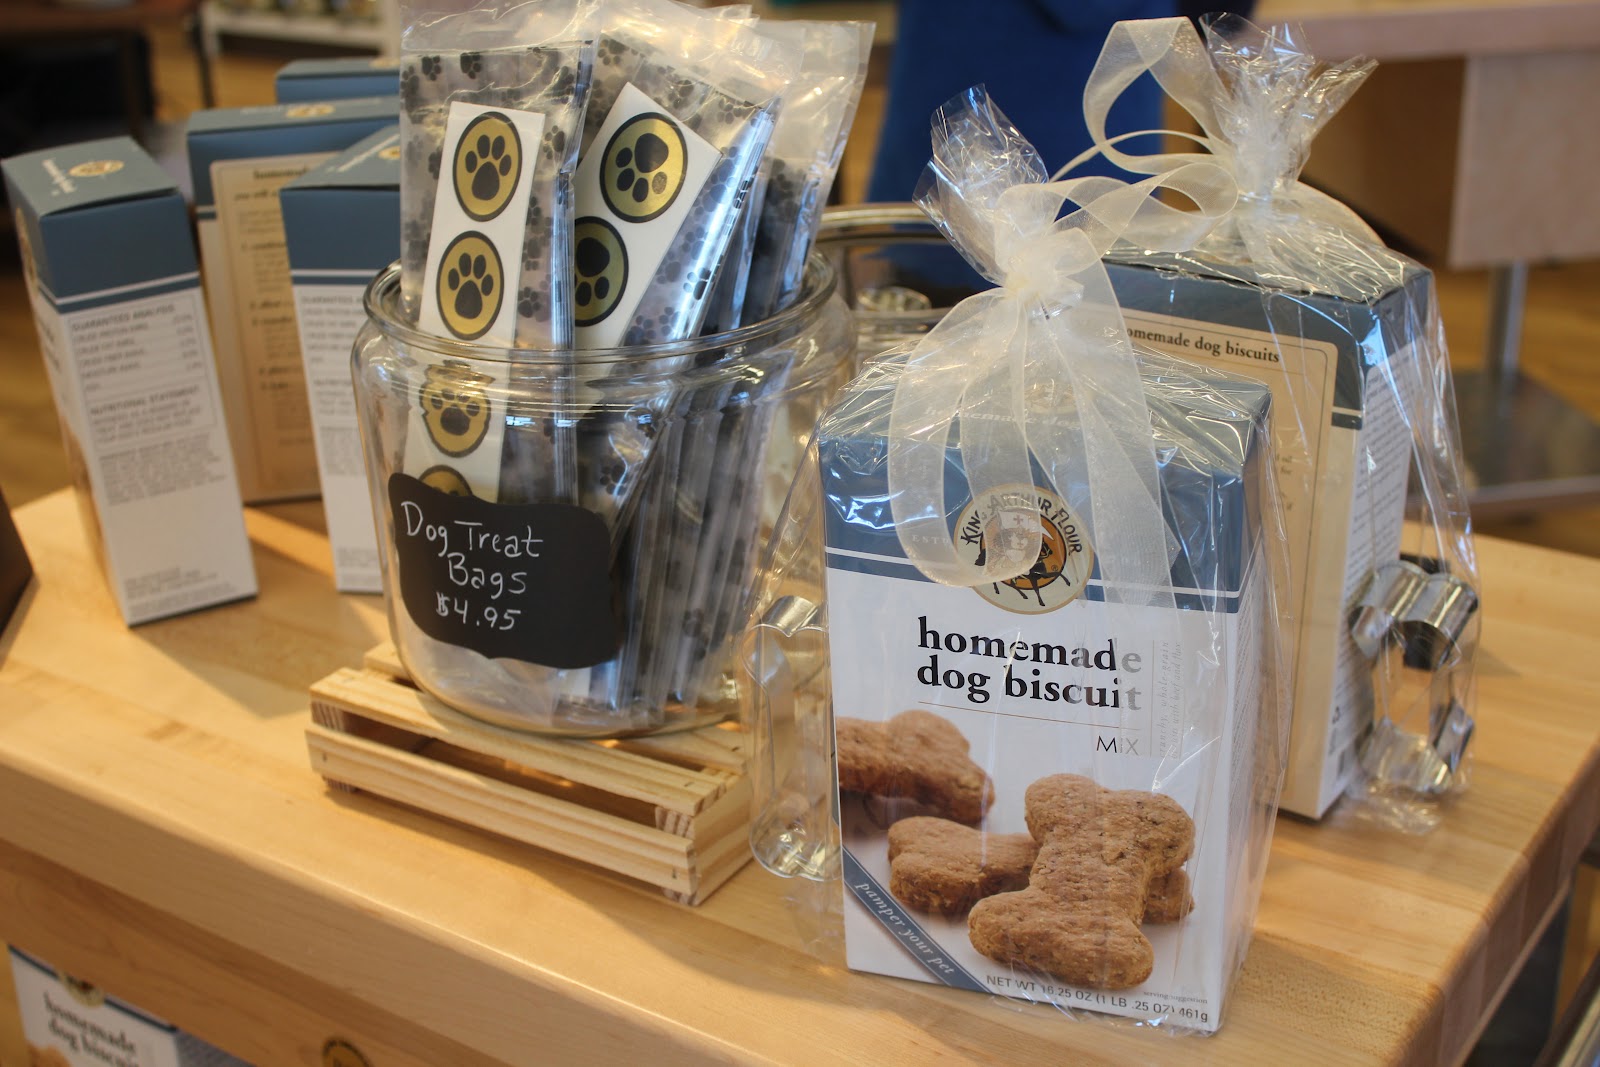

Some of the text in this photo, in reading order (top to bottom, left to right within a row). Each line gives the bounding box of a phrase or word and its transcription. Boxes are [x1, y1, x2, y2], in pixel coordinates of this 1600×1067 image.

[1127, 327, 1280, 363] omemade dog biscuits
[400, 500, 544, 557] Dog Treat
[1051, 506, 1083, 557] FLOUR
[447, 552, 528, 600] Bags
[435, 591, 522, 631] $4.95
[917, 615, 1142, 674] homemade
[917, 654, 1142, 711] dog biscuit
[1096, 735, 1139, 757] MIX
[854, 882, 955, 975] pamper your pet
[986, 975, 1012, 988] NET
[1015, 980, 1036, 992] WT
[1041, 984, 1072, 999] 16.25
[1075, 990, 1093, 1002] OZ
[1096, 993, 1106, 1004] (1
[1111, 997, 1127, 1008] LB
[1131, 1000, 1149, 1012] .25
[1178, 1007, 1208, 1023] 461g
